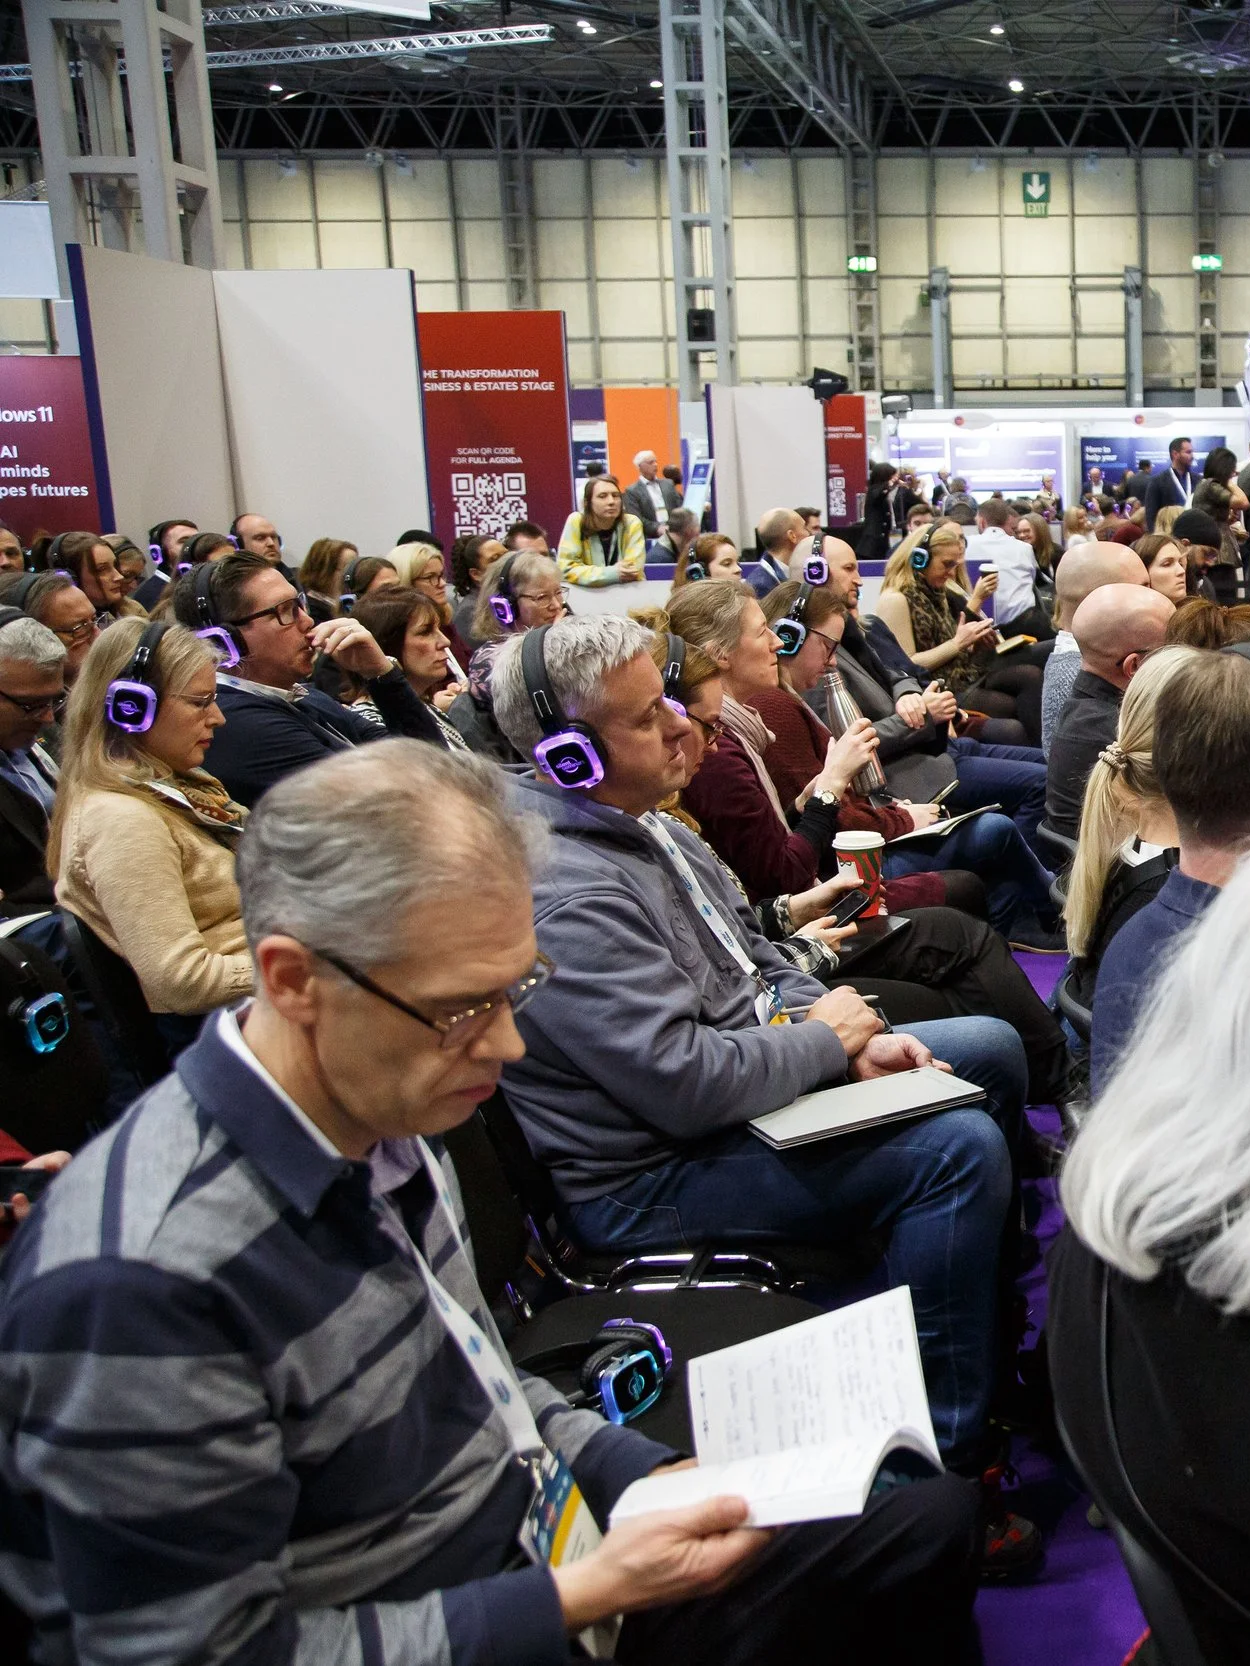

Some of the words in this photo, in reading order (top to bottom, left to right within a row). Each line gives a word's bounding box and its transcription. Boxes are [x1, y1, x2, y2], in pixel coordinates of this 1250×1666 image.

[423, 369, 438, 378] HE
[440, 369, 539, 378] TRANSFORMATION
[424, 382, 461, 391] SINESS
[464, 382, 472, 391] &
[474, 381, 519, 391] ESTATES
[521, 381, 555, 391] STAGE
[38, 406, 54, 422] 11
[1, 445, 18, 458] AI
[457, 447, 479, 455] SCAN
[480, 447, 492, 455] QR
[493, 447, 515, 455] CODE
[1, 464, 50, 477] minds
[0, 484, 27, 499] pes
[31, 483, 88, 497] futures
